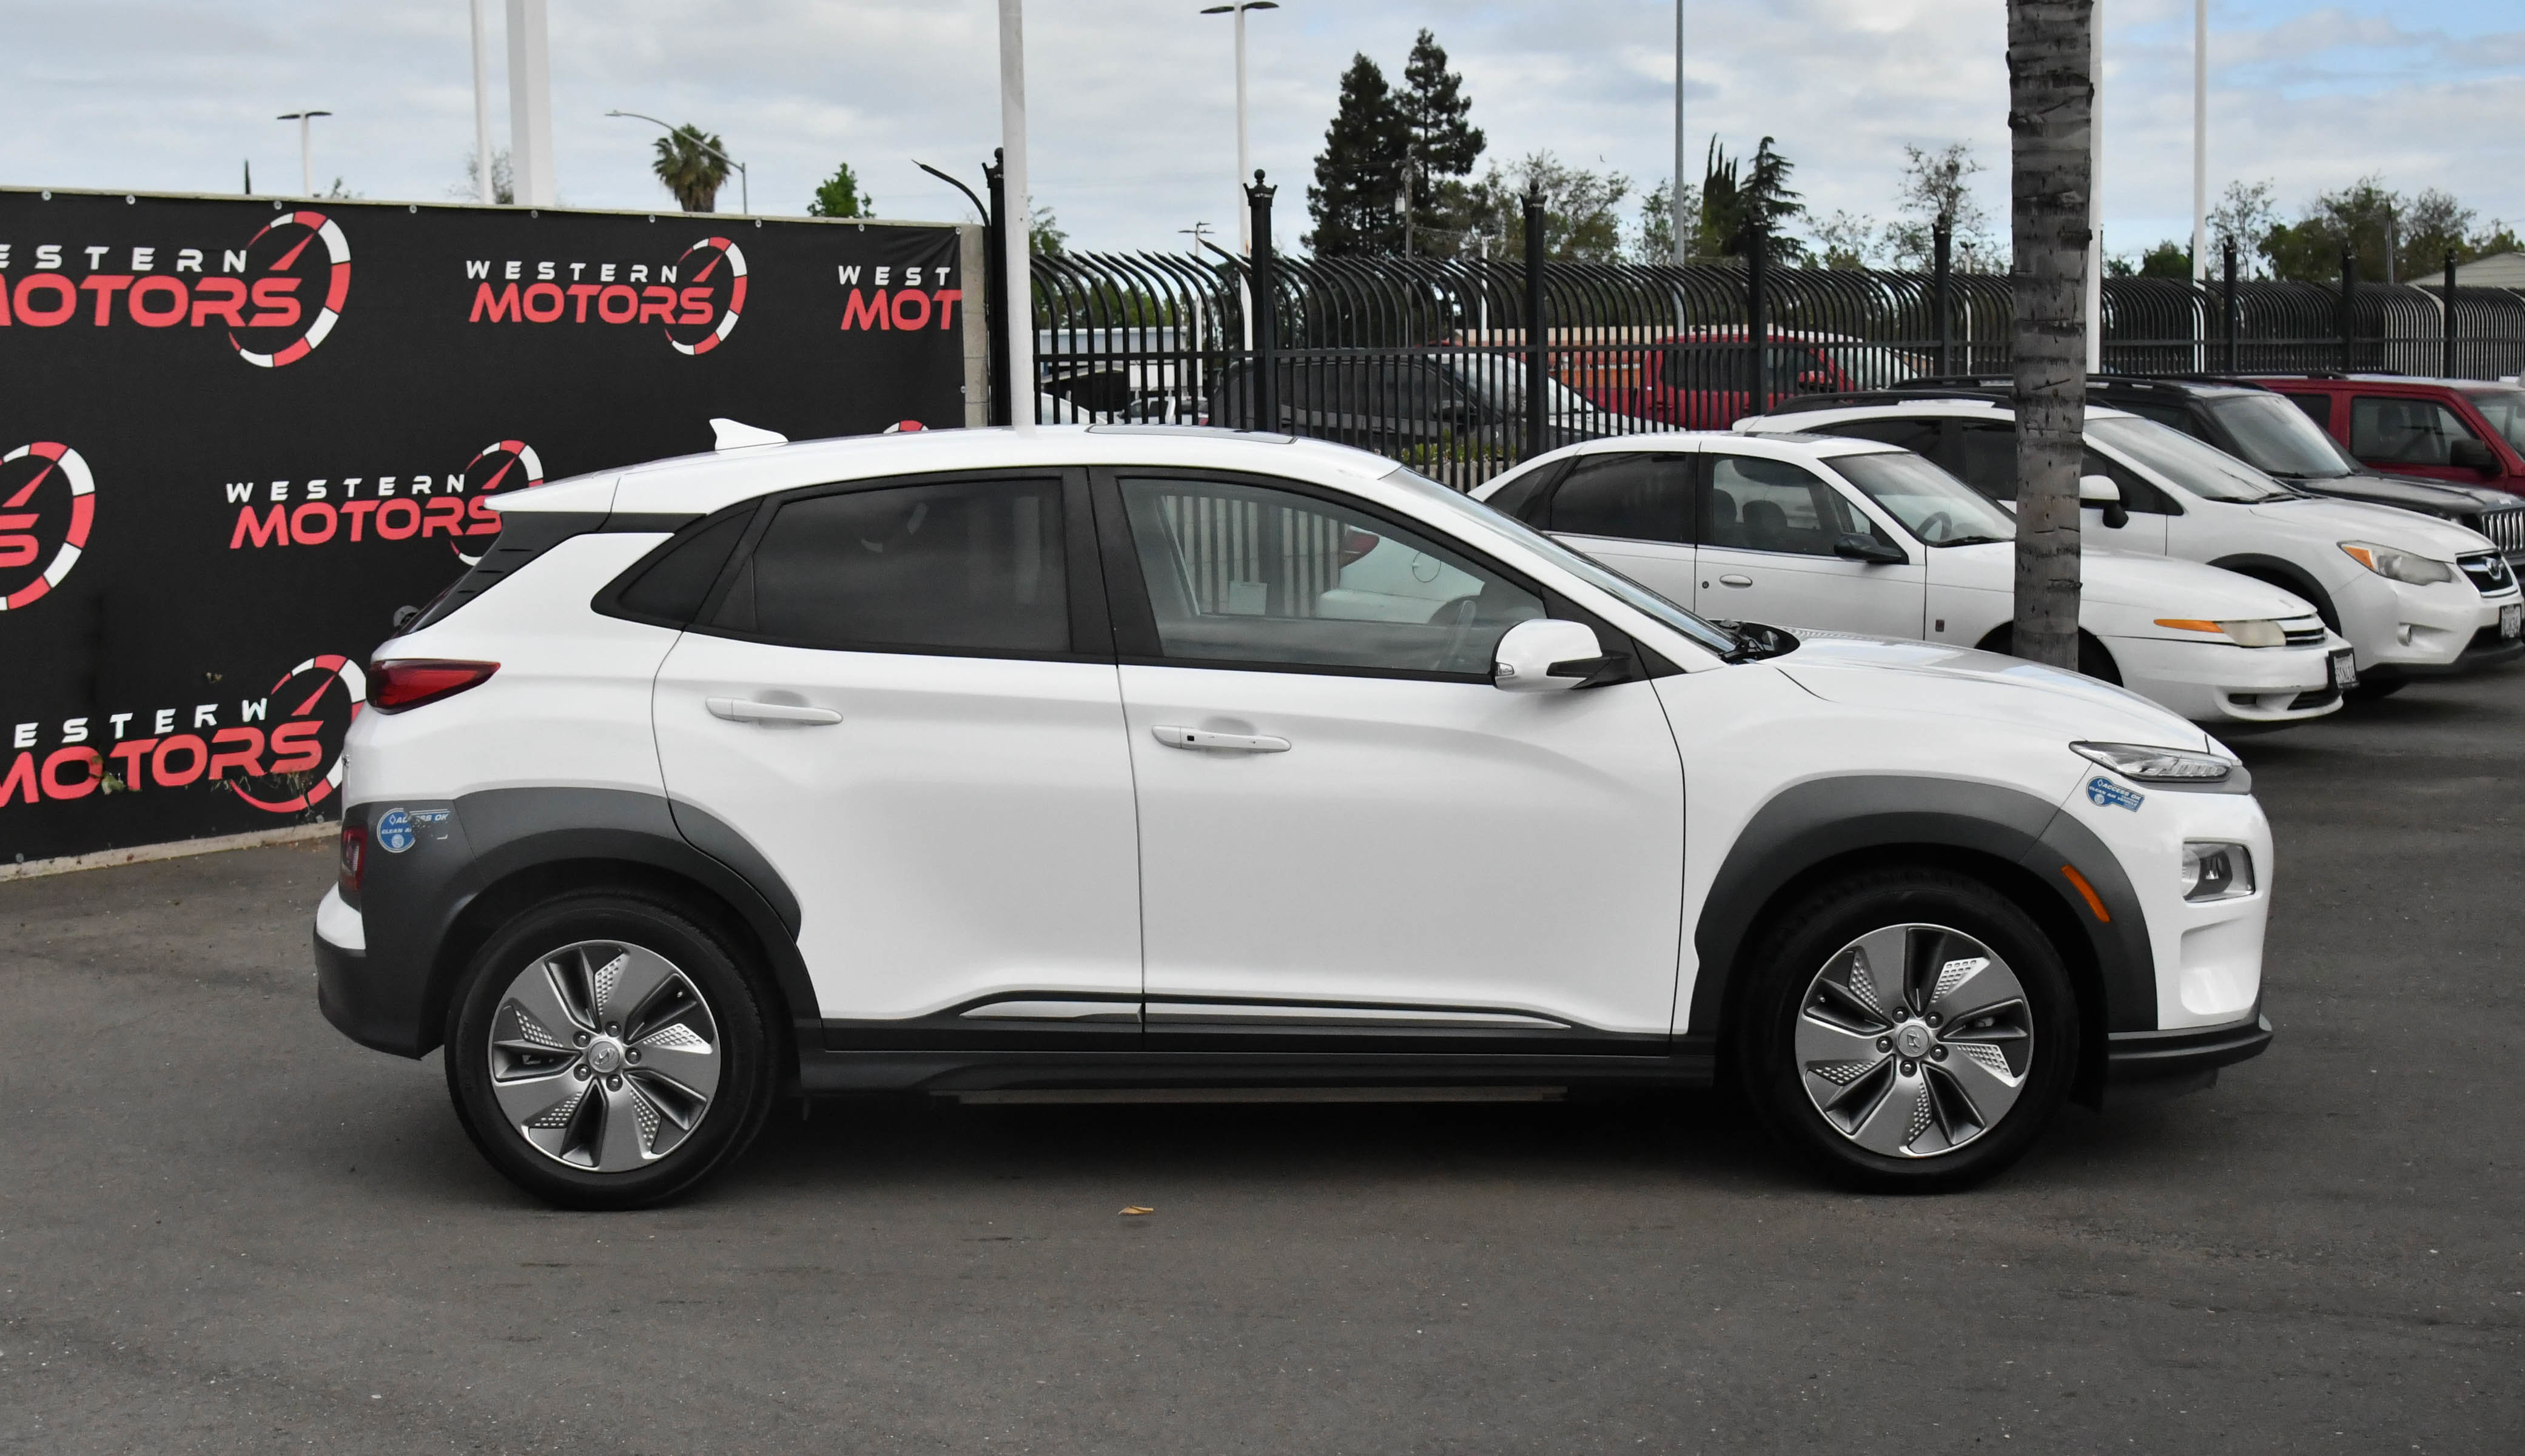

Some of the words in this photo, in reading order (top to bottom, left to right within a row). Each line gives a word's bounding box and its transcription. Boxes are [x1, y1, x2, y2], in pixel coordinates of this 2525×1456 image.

[466, 260, 677, 283] WESTERN
[838, 265, 950, 286] WEST
[0, 272, 301, 327] OTORS
[468, 282, 714, 324] MOTORS
[841, 287, 962, 331] MOT
[226, 474, 465, 503] WESTERN
[230, 494, 502, 549] MOTORS
[2089, 786, 2106, 794] CLEAN
[2102, 783, 2130, 796] ACCESS
[395, 814, 432, 824] ACSS
